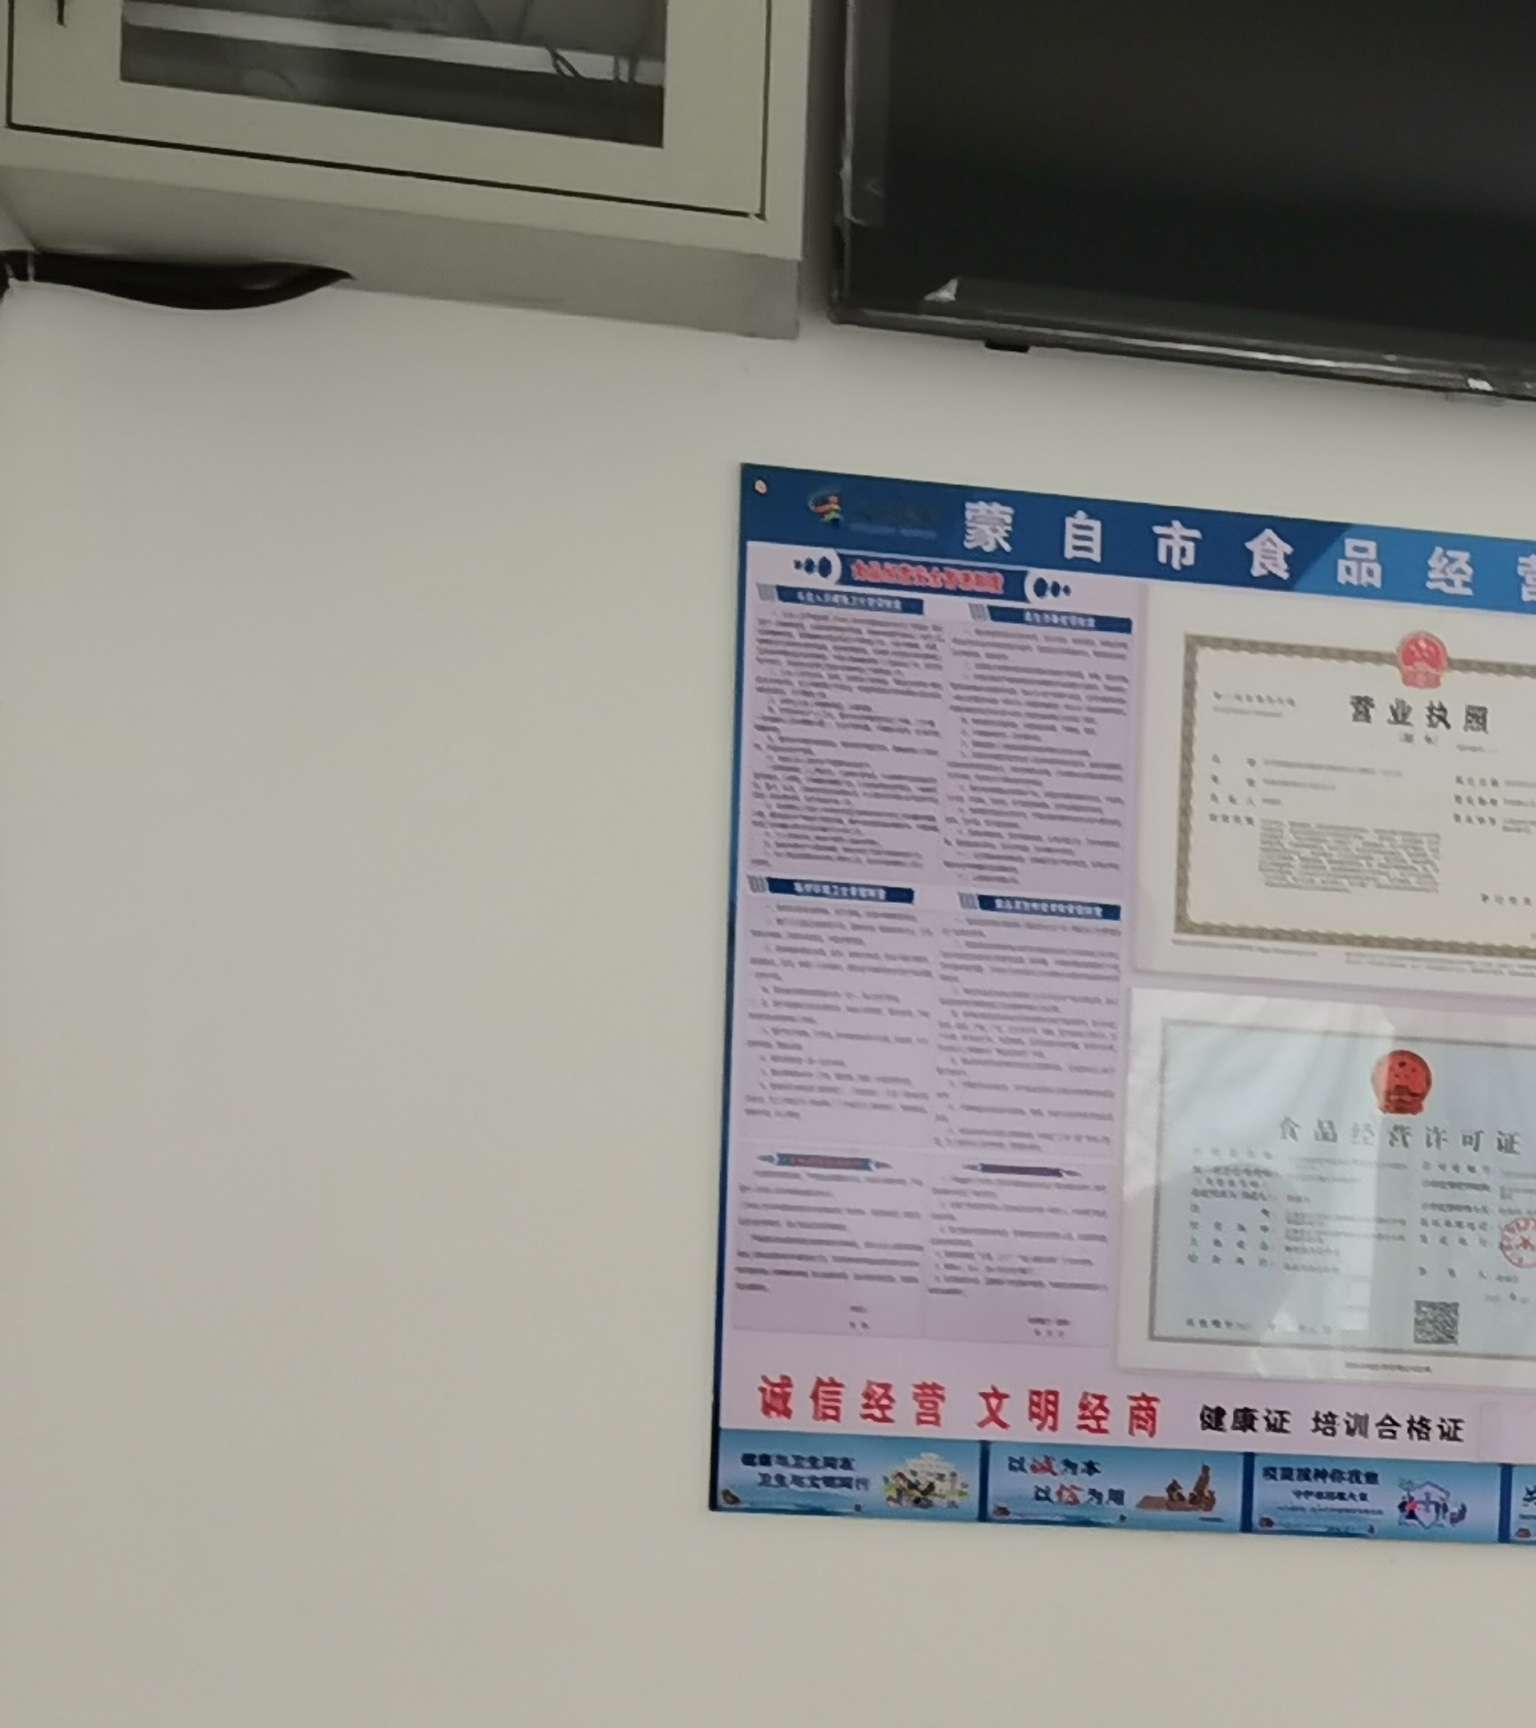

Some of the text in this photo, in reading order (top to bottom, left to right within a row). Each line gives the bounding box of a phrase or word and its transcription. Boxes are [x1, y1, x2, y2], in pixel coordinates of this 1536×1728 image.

[1350, 695, 1489, 733] 营业执照
[758, 1373, 1464, 1443] 诚信经营 文明经商 健康证 培训合格证
